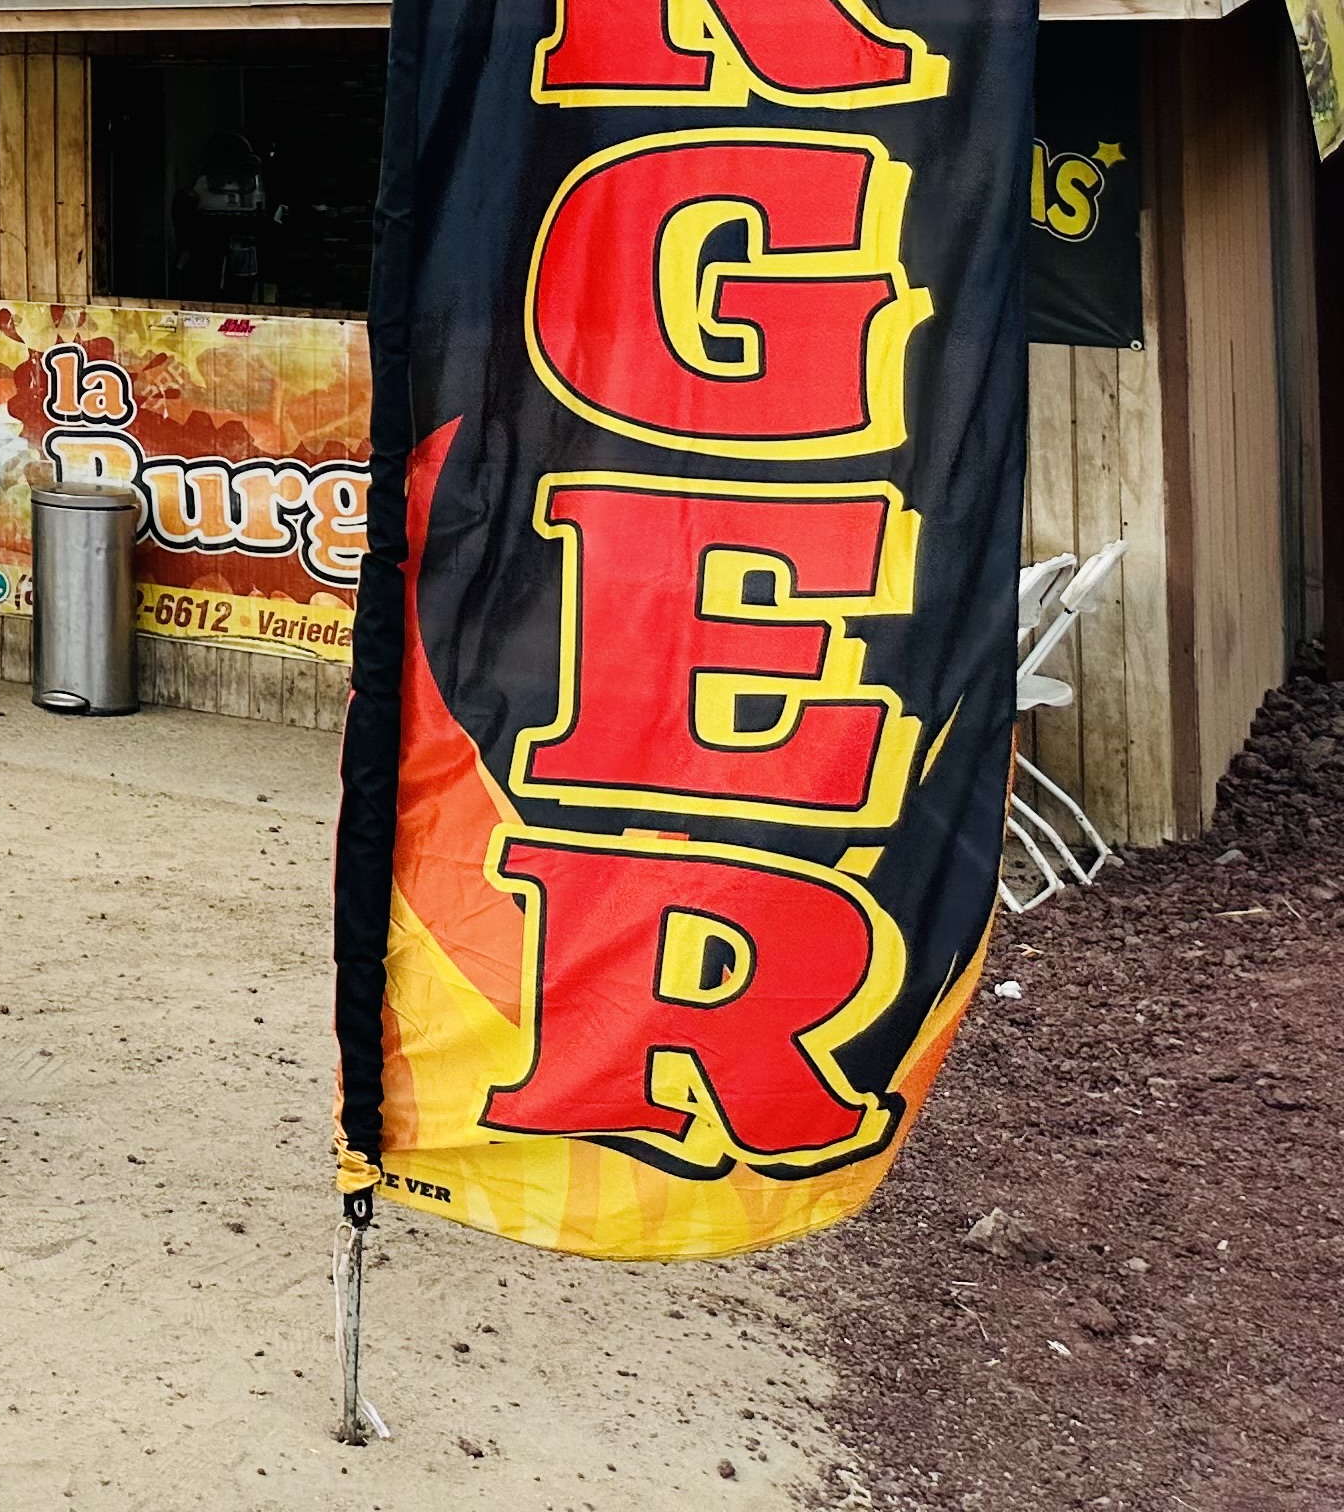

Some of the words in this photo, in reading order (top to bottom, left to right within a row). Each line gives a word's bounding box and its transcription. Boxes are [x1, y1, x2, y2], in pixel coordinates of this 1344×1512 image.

[48, 345, 132, 422] la
[258, 609, 355, 647] Varieda
[405, 1177, 451, 1204] VER
